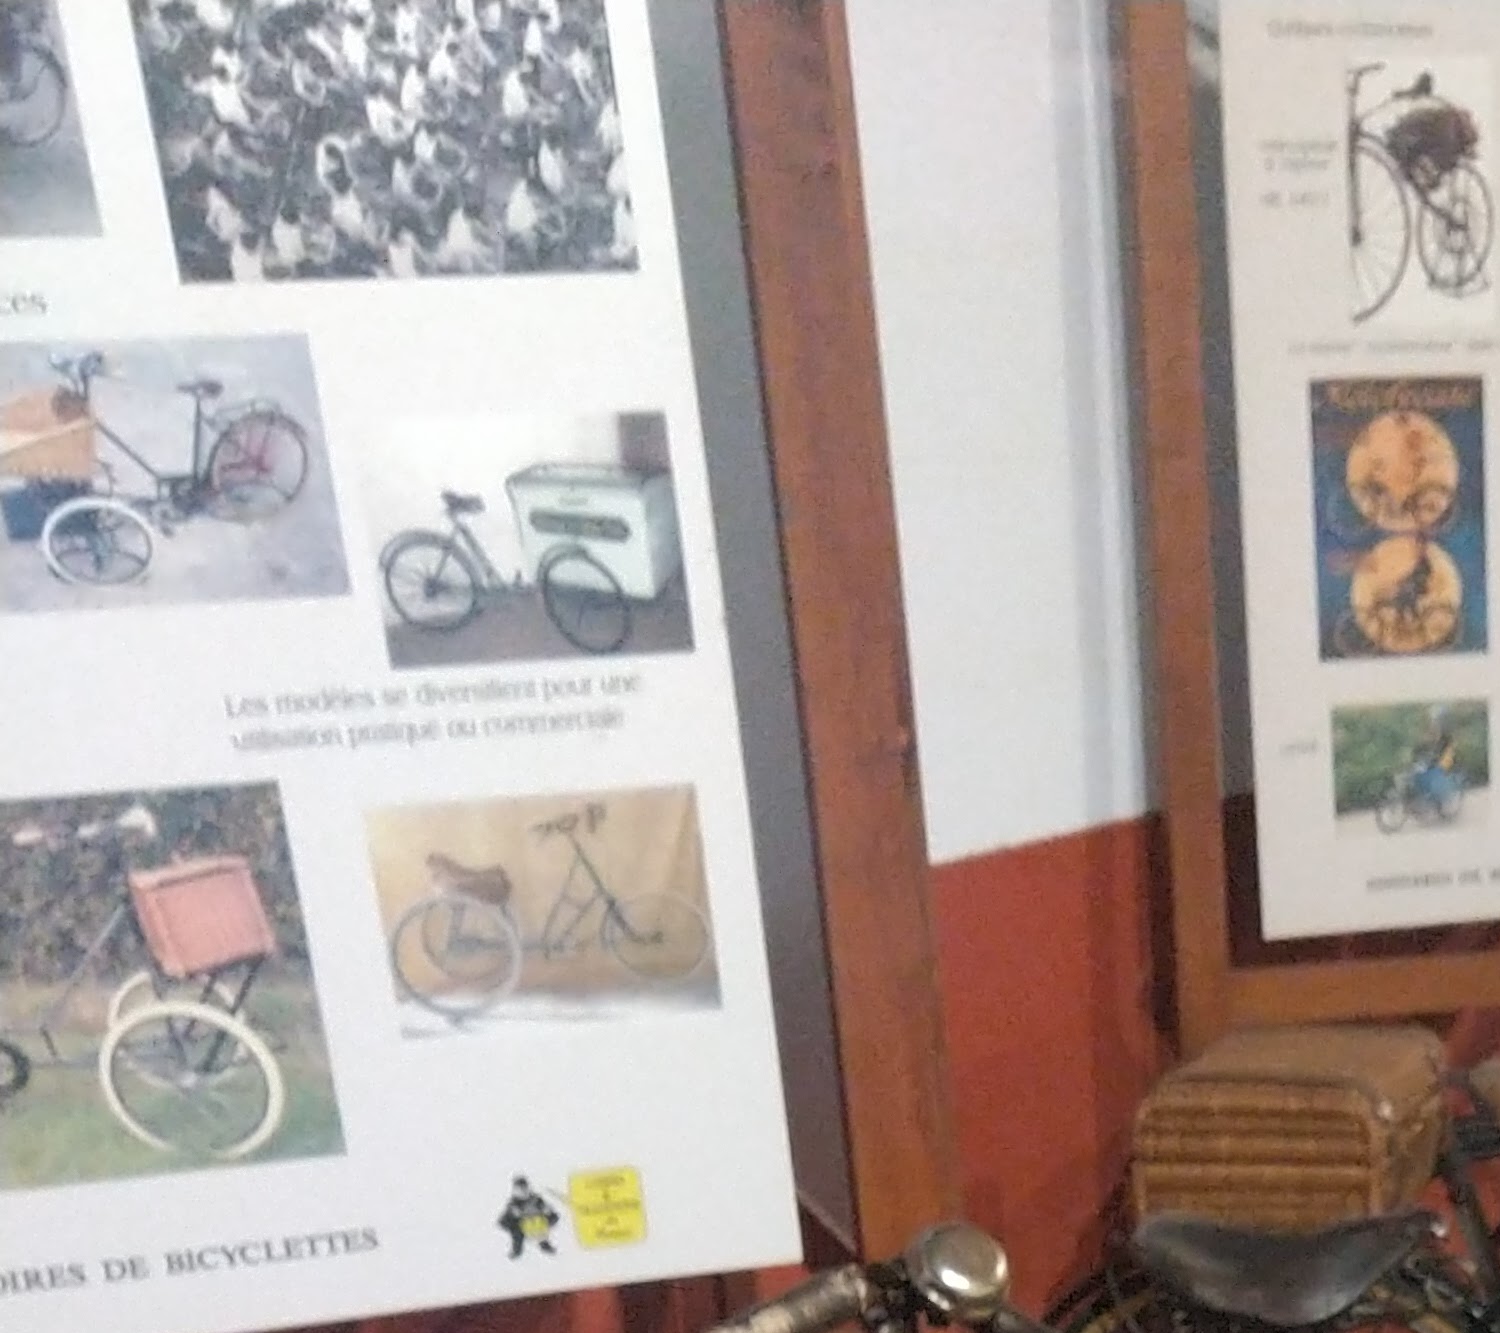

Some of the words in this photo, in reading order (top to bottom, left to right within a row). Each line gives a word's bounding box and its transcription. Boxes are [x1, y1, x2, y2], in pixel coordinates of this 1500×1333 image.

[541, 676, 592, 703] pour
[0, 1261, 86, 1295] IRES
[101, 1254, 150, 1283] DE
[164, 1225, 380, 1277] BICYCLETTES
